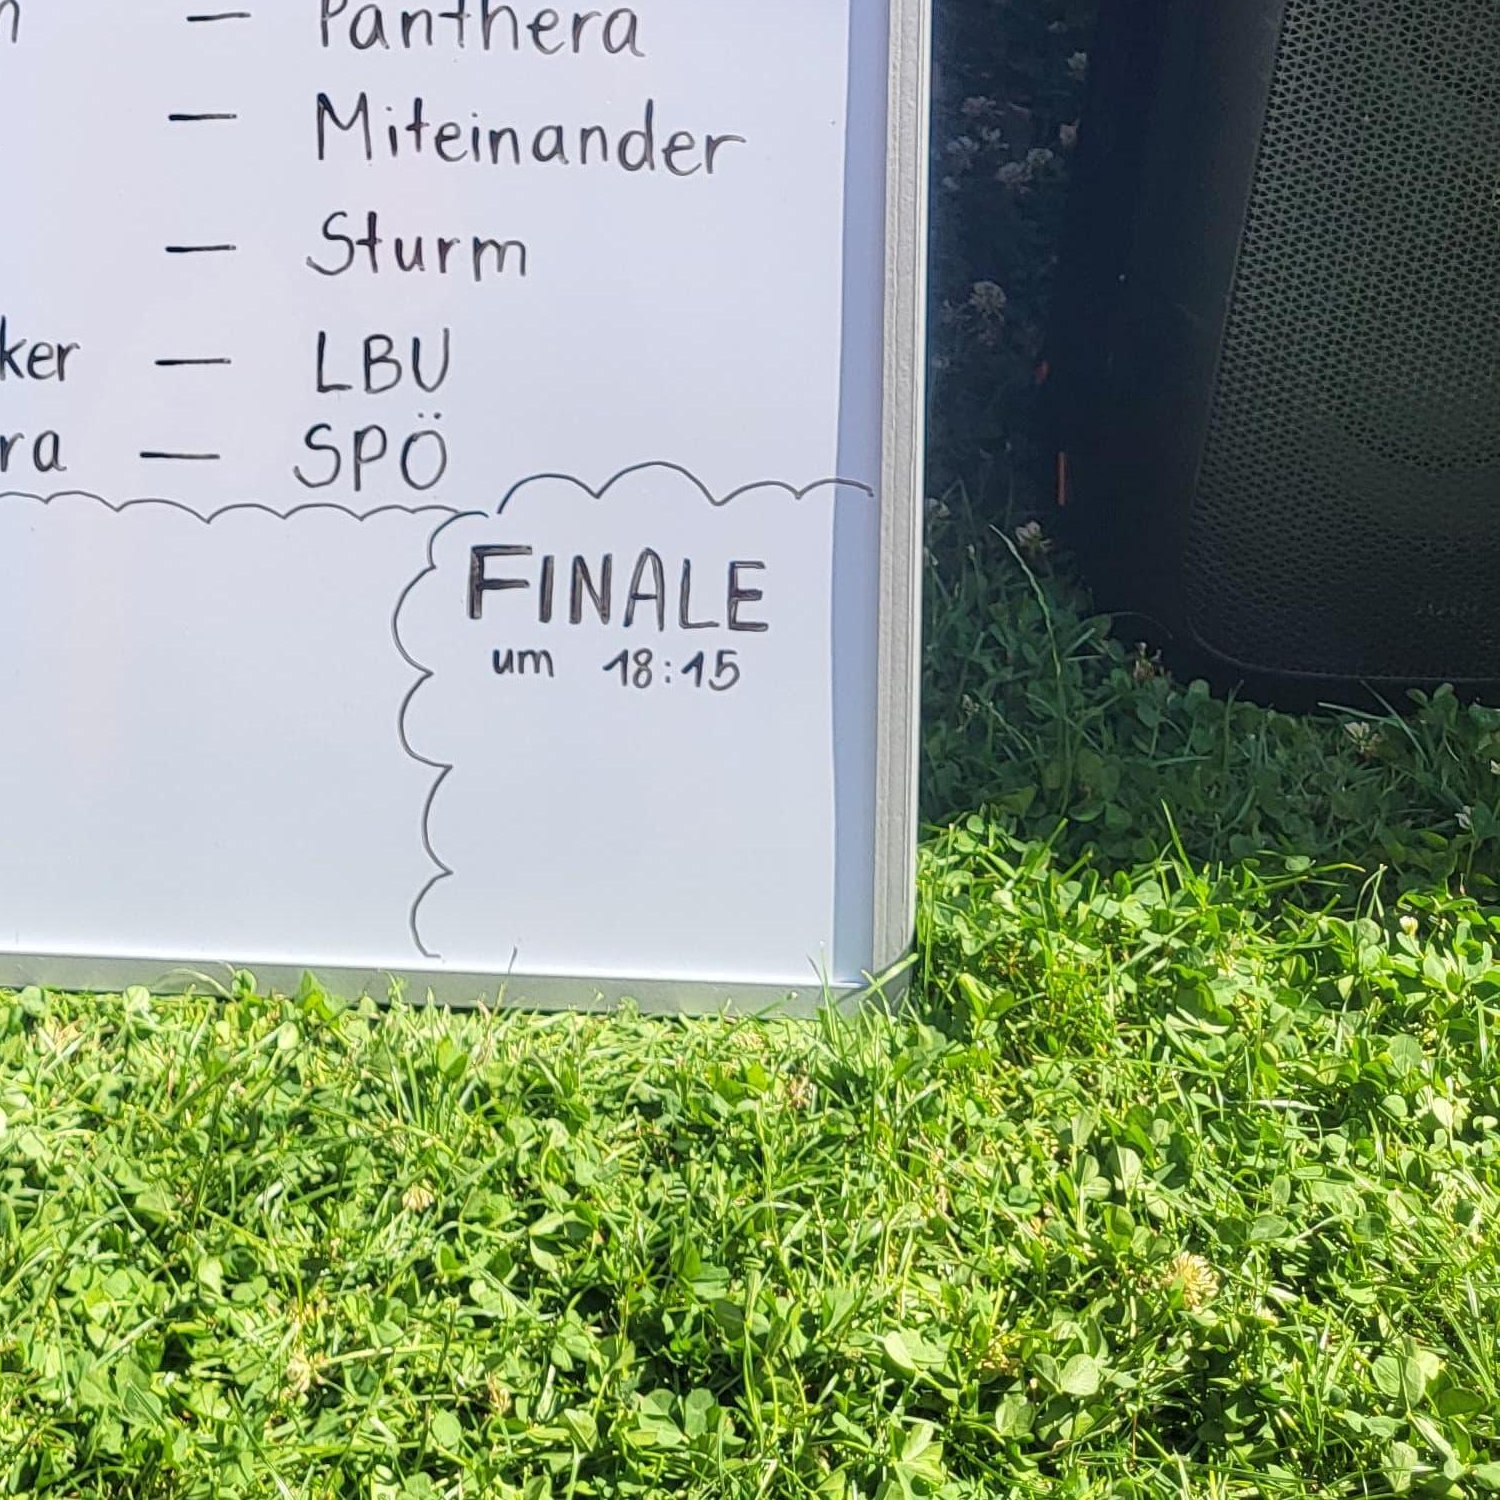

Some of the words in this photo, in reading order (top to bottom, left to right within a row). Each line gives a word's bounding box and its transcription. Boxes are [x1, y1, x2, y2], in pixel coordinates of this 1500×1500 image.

[316, 91, 747, 176] Miteinander
[306, 210, 526, 282] Sturm
[316, 327, 450, 394] LBU
[293, 409, 449, 492] SPÖ
[467, 544, 769, 632] FINALE
[492, 648, 554, 678] um
[602, 648, 740, 691] 18:15
